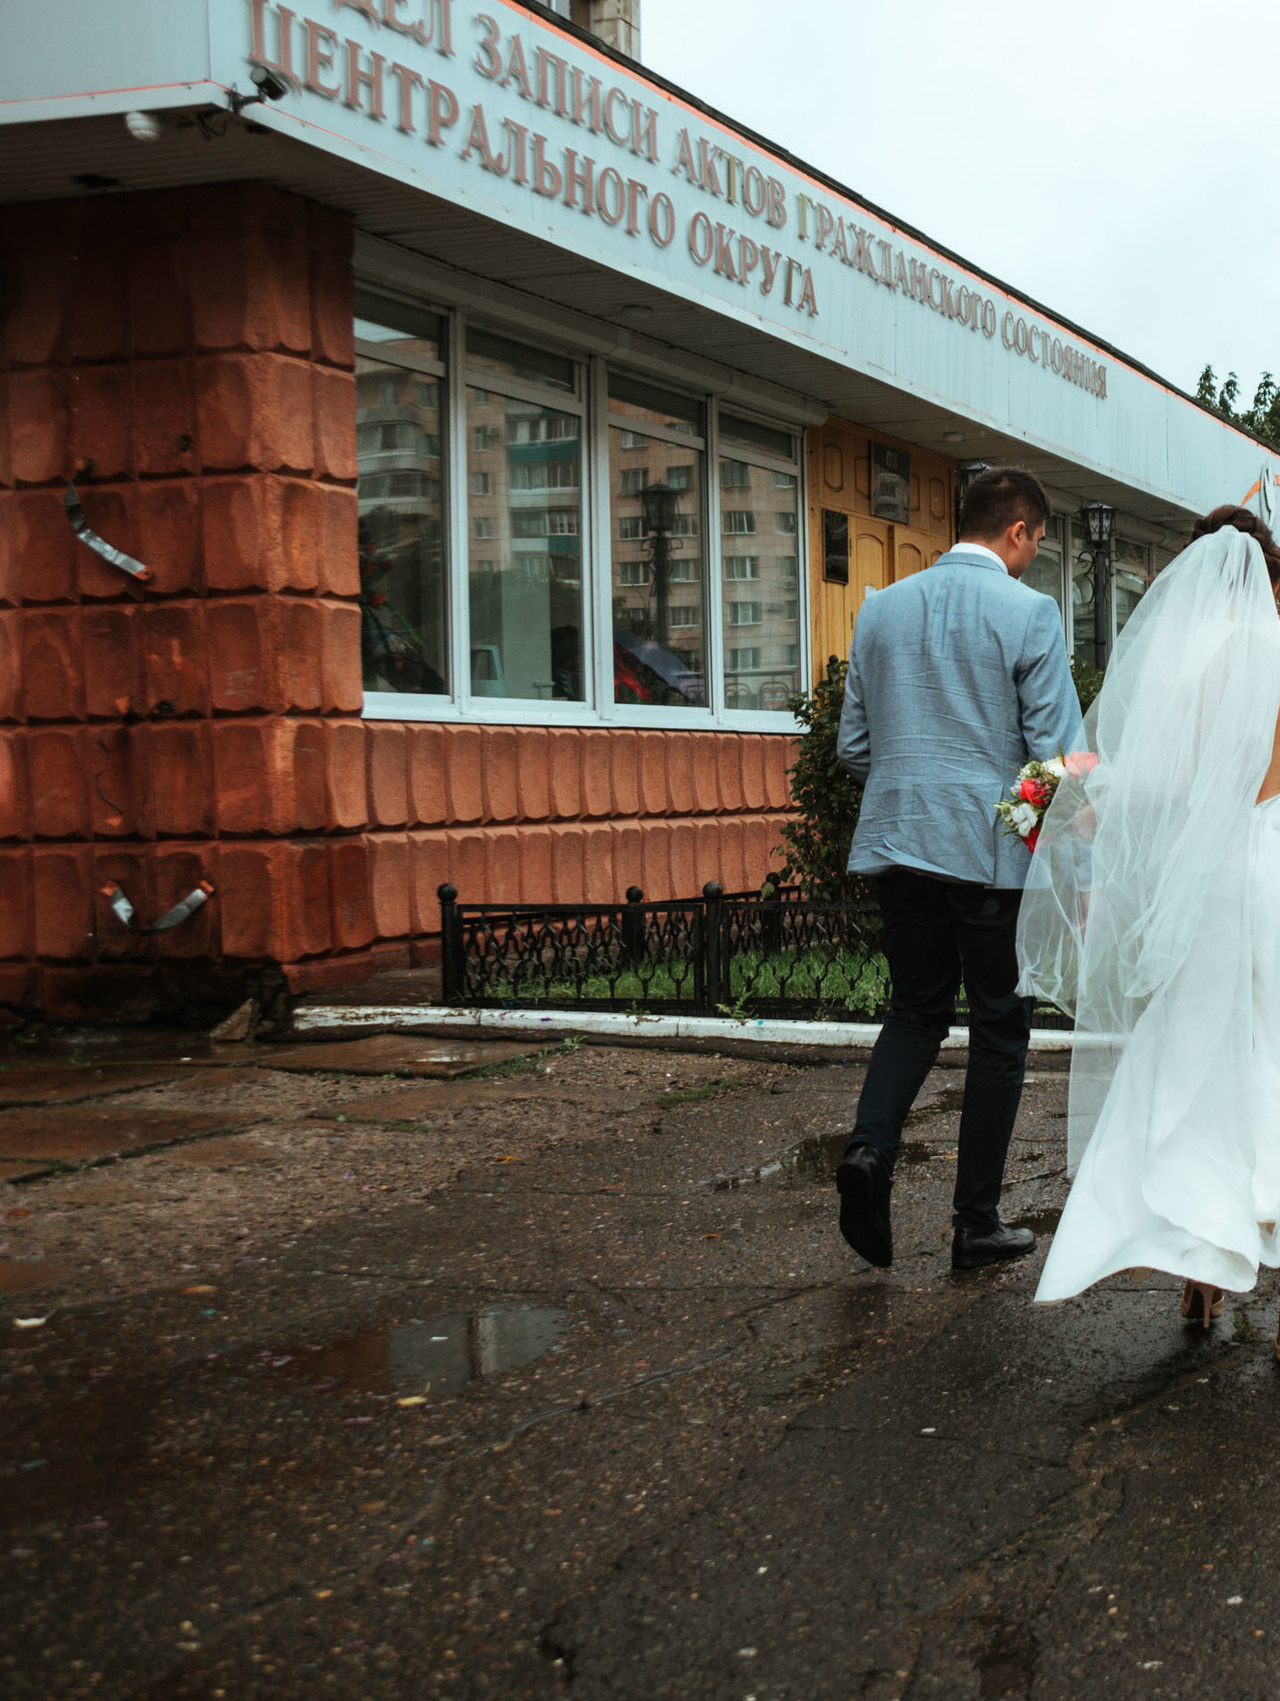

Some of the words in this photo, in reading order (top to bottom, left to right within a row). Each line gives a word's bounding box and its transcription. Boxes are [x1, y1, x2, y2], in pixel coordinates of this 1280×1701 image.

[250, 0, 674, 247] ЦЕНТРАЛЬНОГО
[690, 211, 819, 317] ОКРУГА
[476, 13, 660, 163] ЗАПИСИ
[673, 127, 787, 229] АКТОВ
[797, 192, 997, 340] ГРАЖДАНСКОГО
[1001, 309, 1109, 400] СОСТОЯНИЯ
